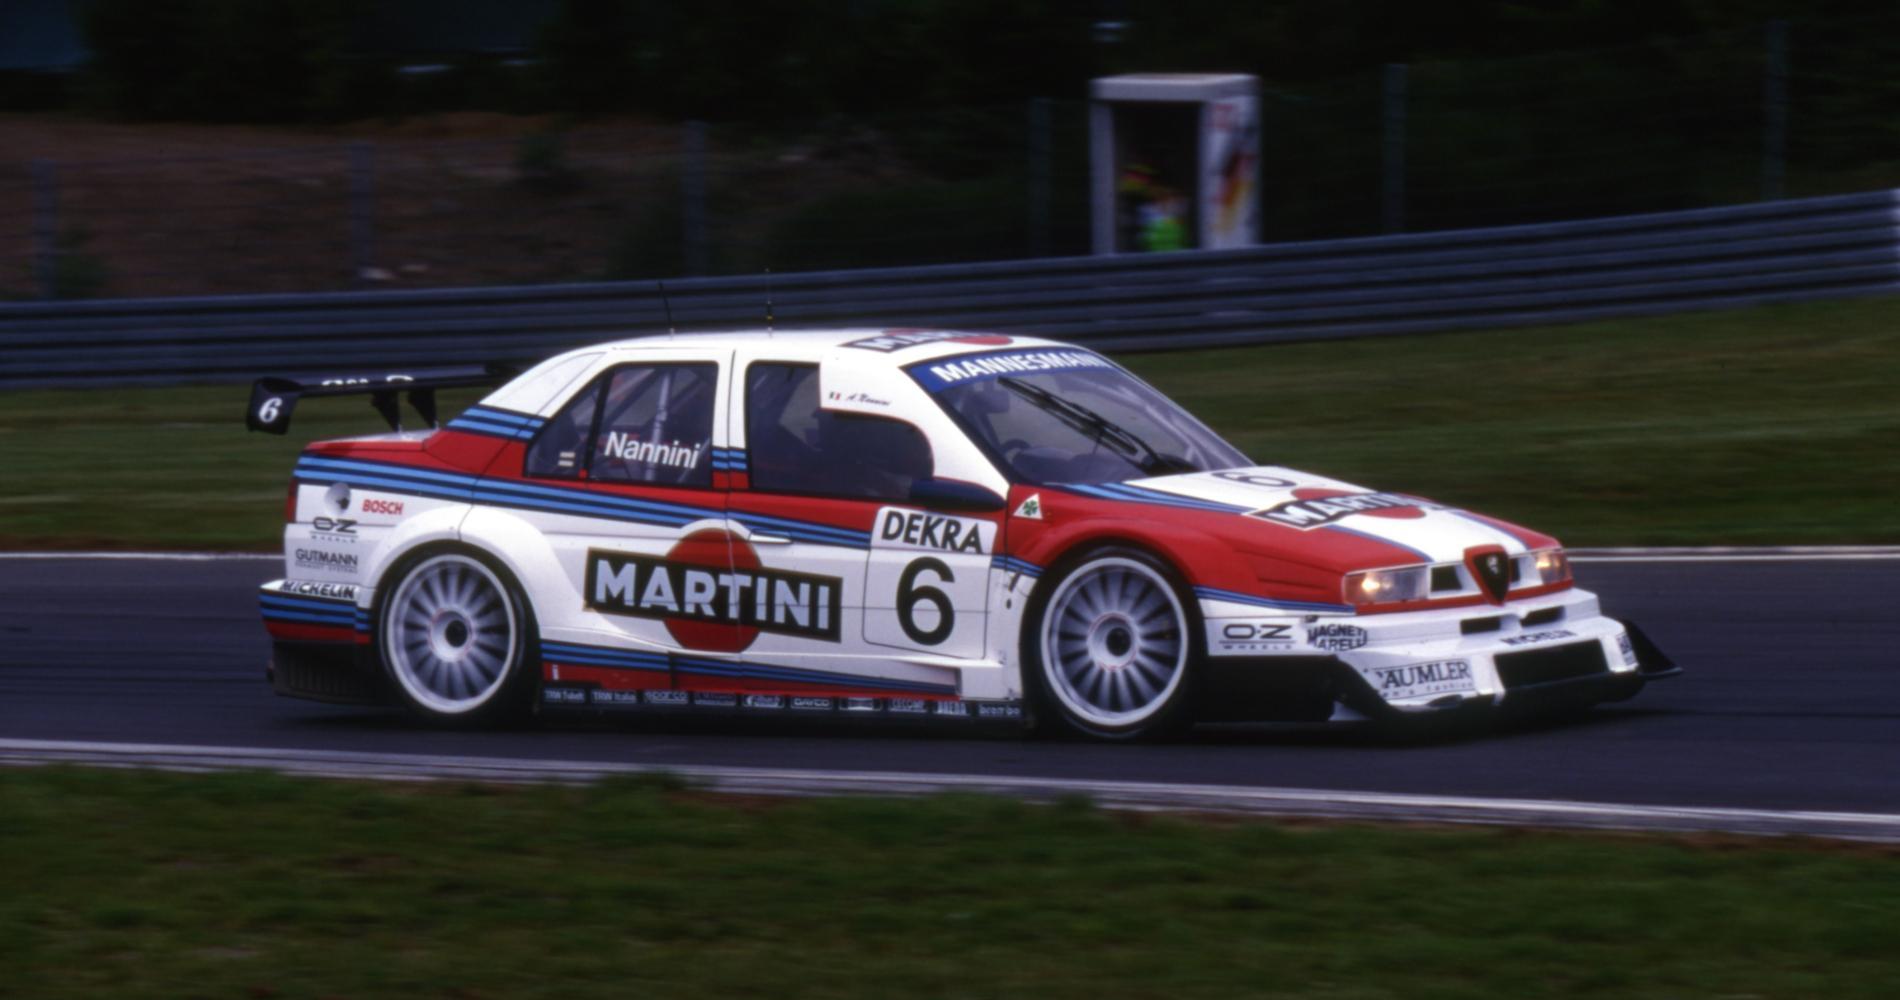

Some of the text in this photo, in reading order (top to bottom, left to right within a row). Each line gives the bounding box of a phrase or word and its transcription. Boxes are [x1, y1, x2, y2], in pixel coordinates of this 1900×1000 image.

[259, 397, 282, 422] 6
[604, 431, 700, 469] Nannini
[1211, 471, 1297, 488] 6
[362, 499, 404, 515] BOSCH
[881, 510, 983, 555] DEKRA
[295, 548, 359, 566] GUTMANN
[282, 581, 355, 598] MICHELIN
[595, 559, 830, 630] MARTINI
[896, 556, 955, 646] 6
